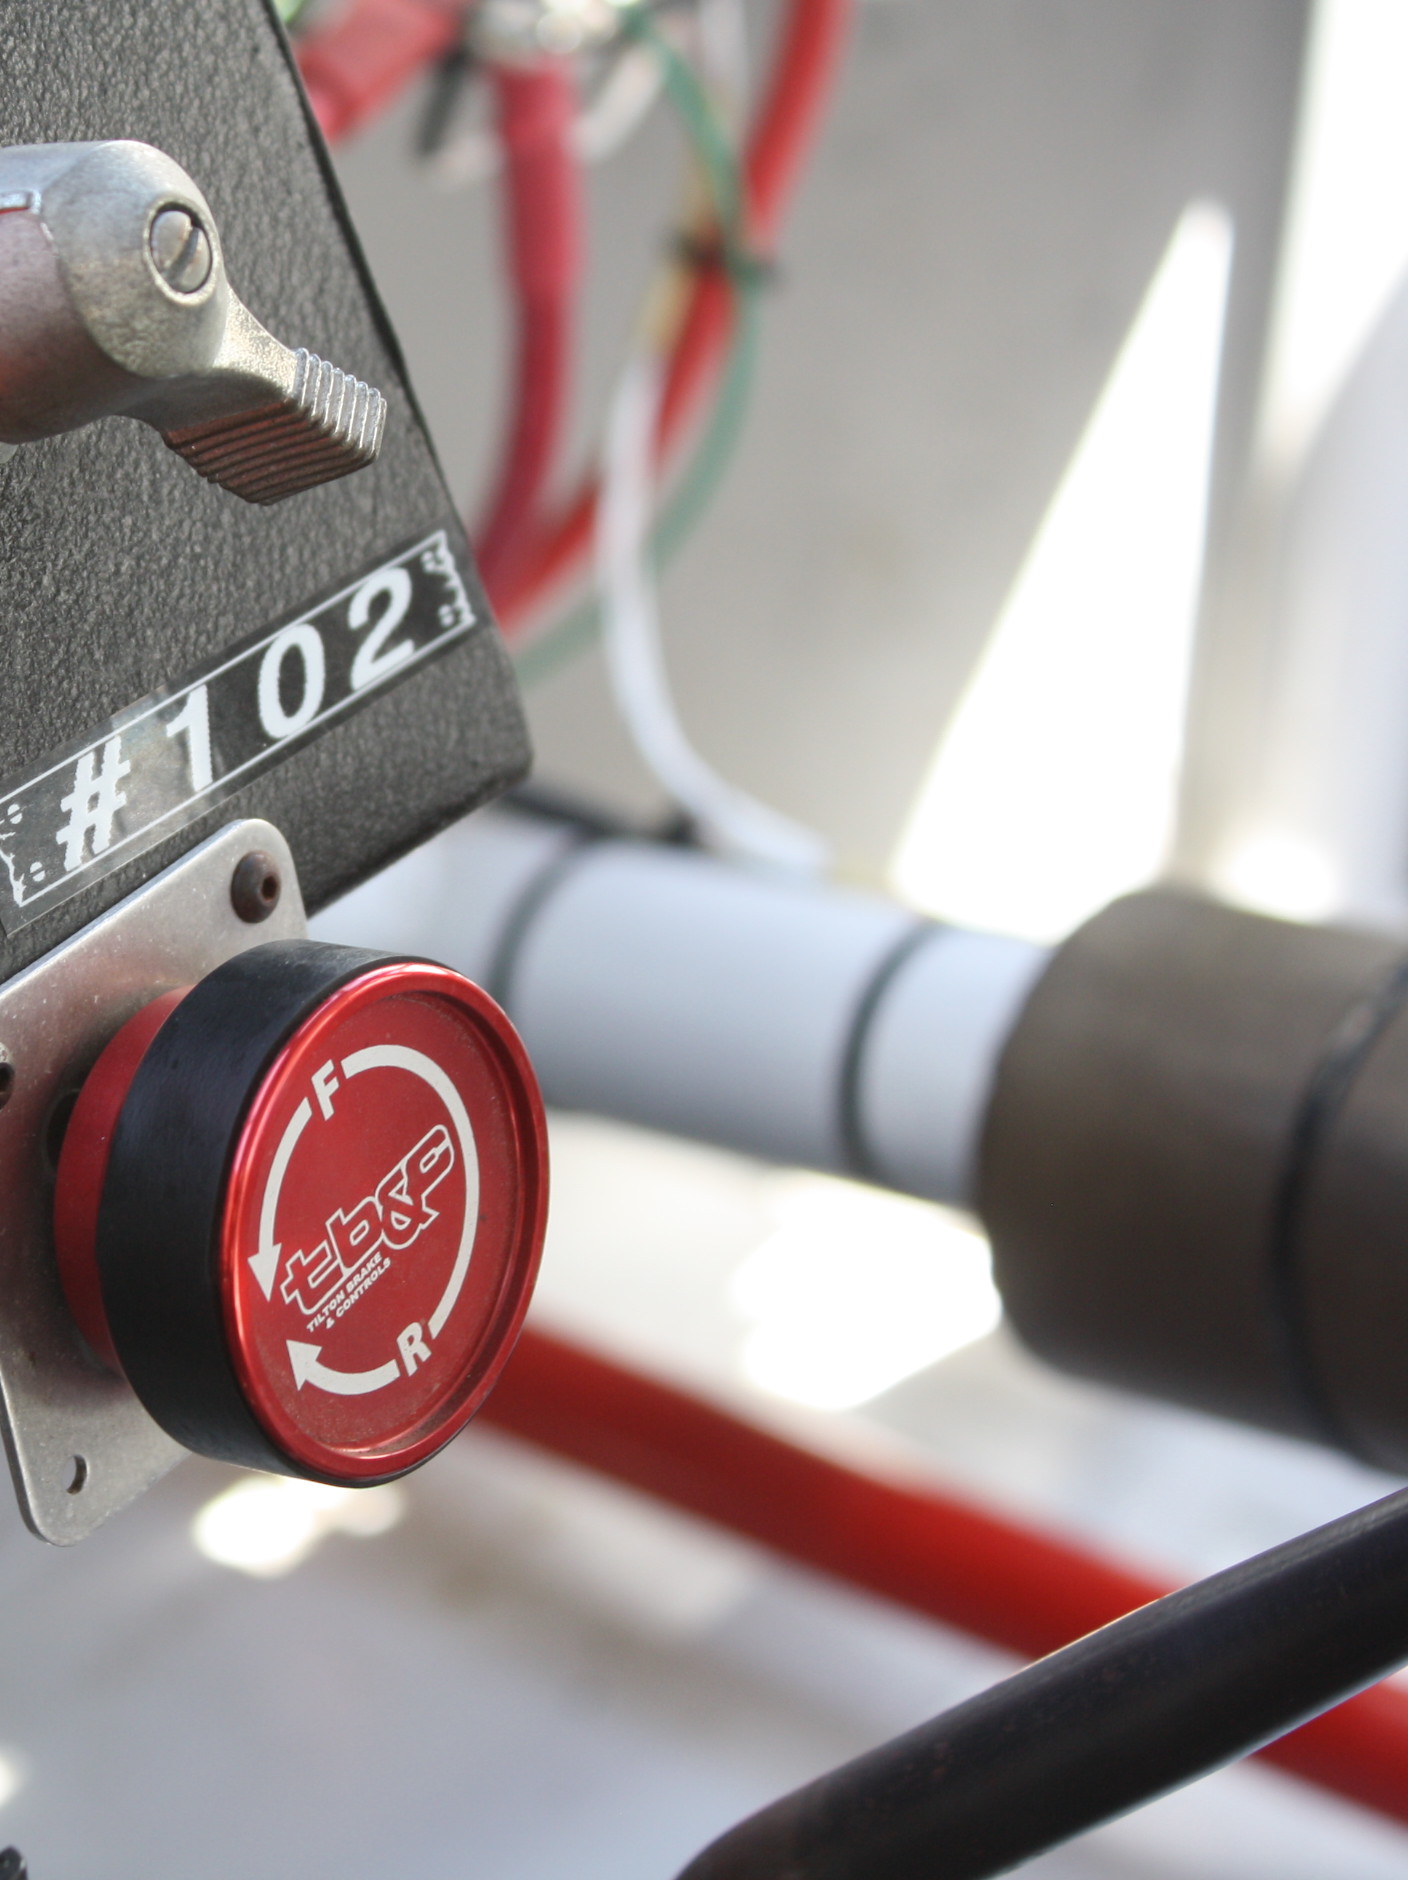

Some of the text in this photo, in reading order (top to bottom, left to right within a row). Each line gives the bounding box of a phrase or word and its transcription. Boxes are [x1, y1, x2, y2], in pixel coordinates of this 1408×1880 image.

[55, 566, 415, 872] #102
[310, 1059, 340, 1122] F
[306, 1251, 382, 1333] TILTON BRAKE
[336, 1257, 391, 1317] CONTROLS
[395, 1321, 432, 1376] R
